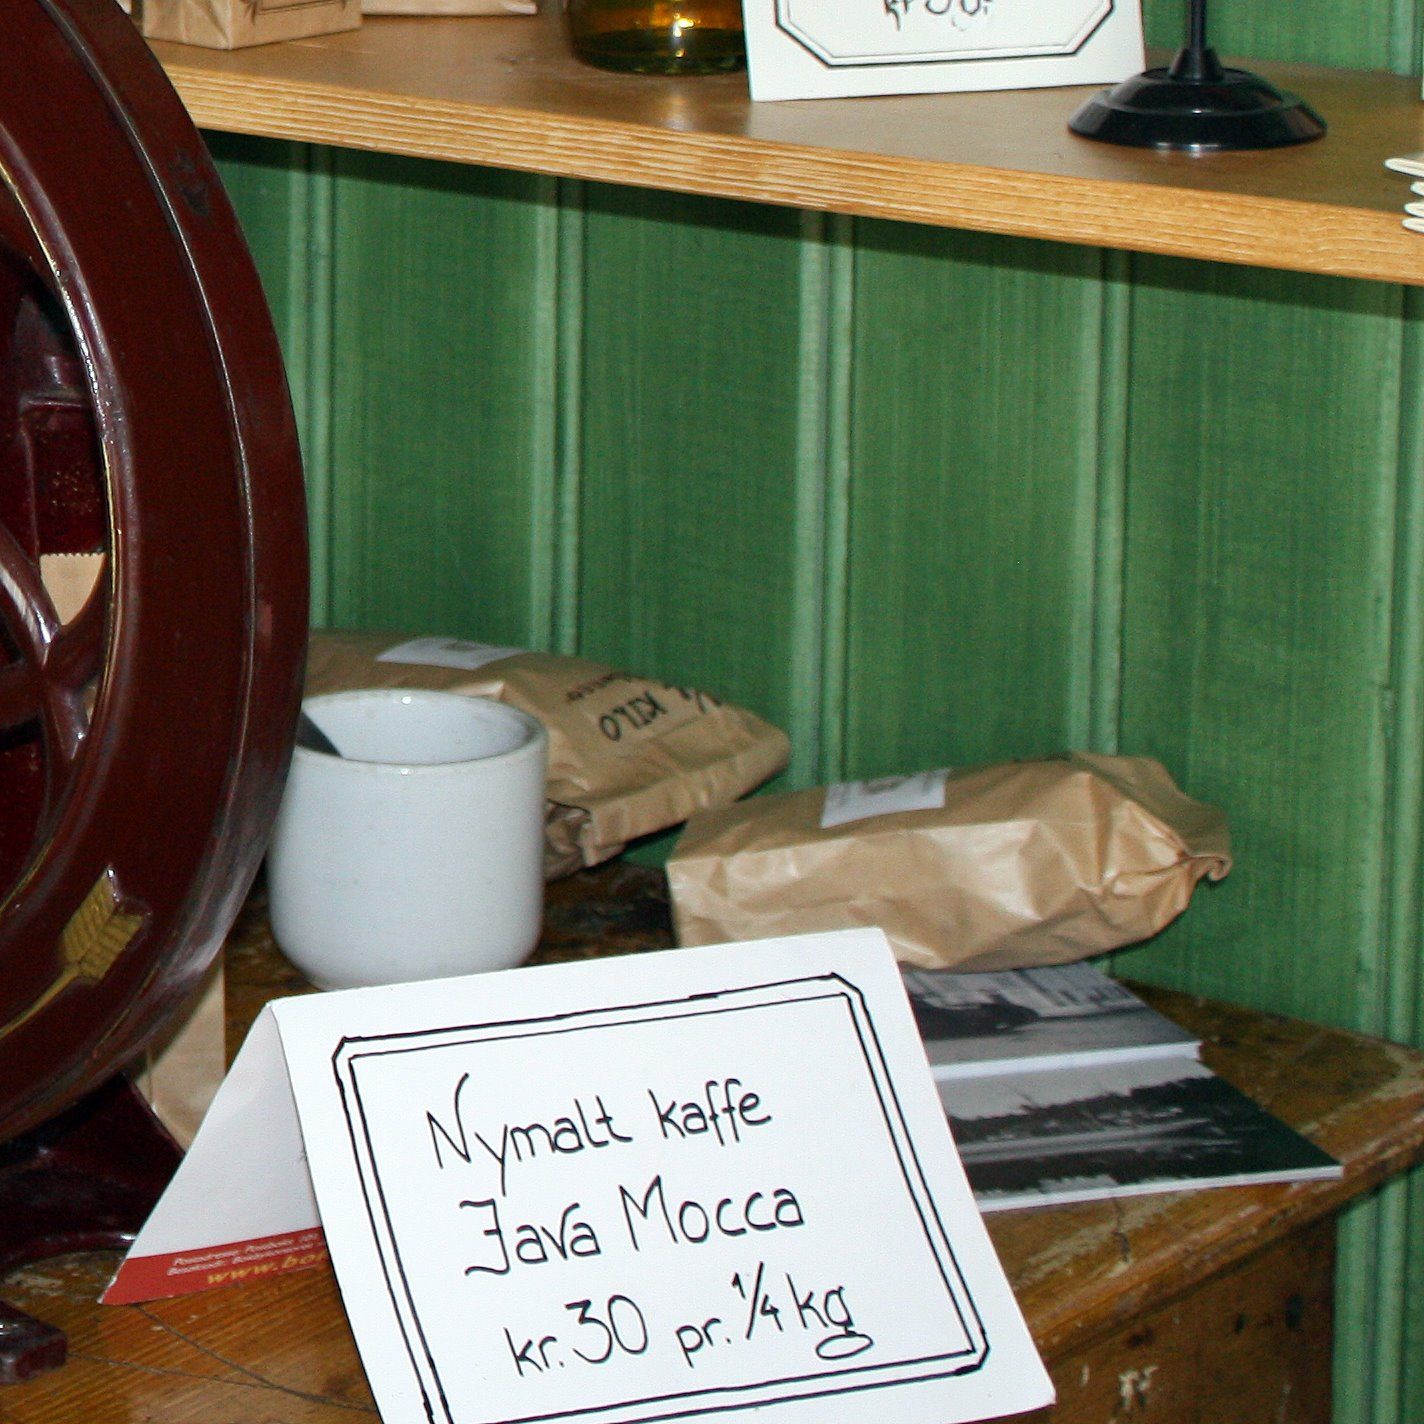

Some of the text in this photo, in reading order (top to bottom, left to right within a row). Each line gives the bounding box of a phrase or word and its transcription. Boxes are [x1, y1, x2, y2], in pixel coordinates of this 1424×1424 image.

[425, 1072, 773, 1197] Nymalt kaffe
[458, 1174, 806, 1276] Java Mocca
